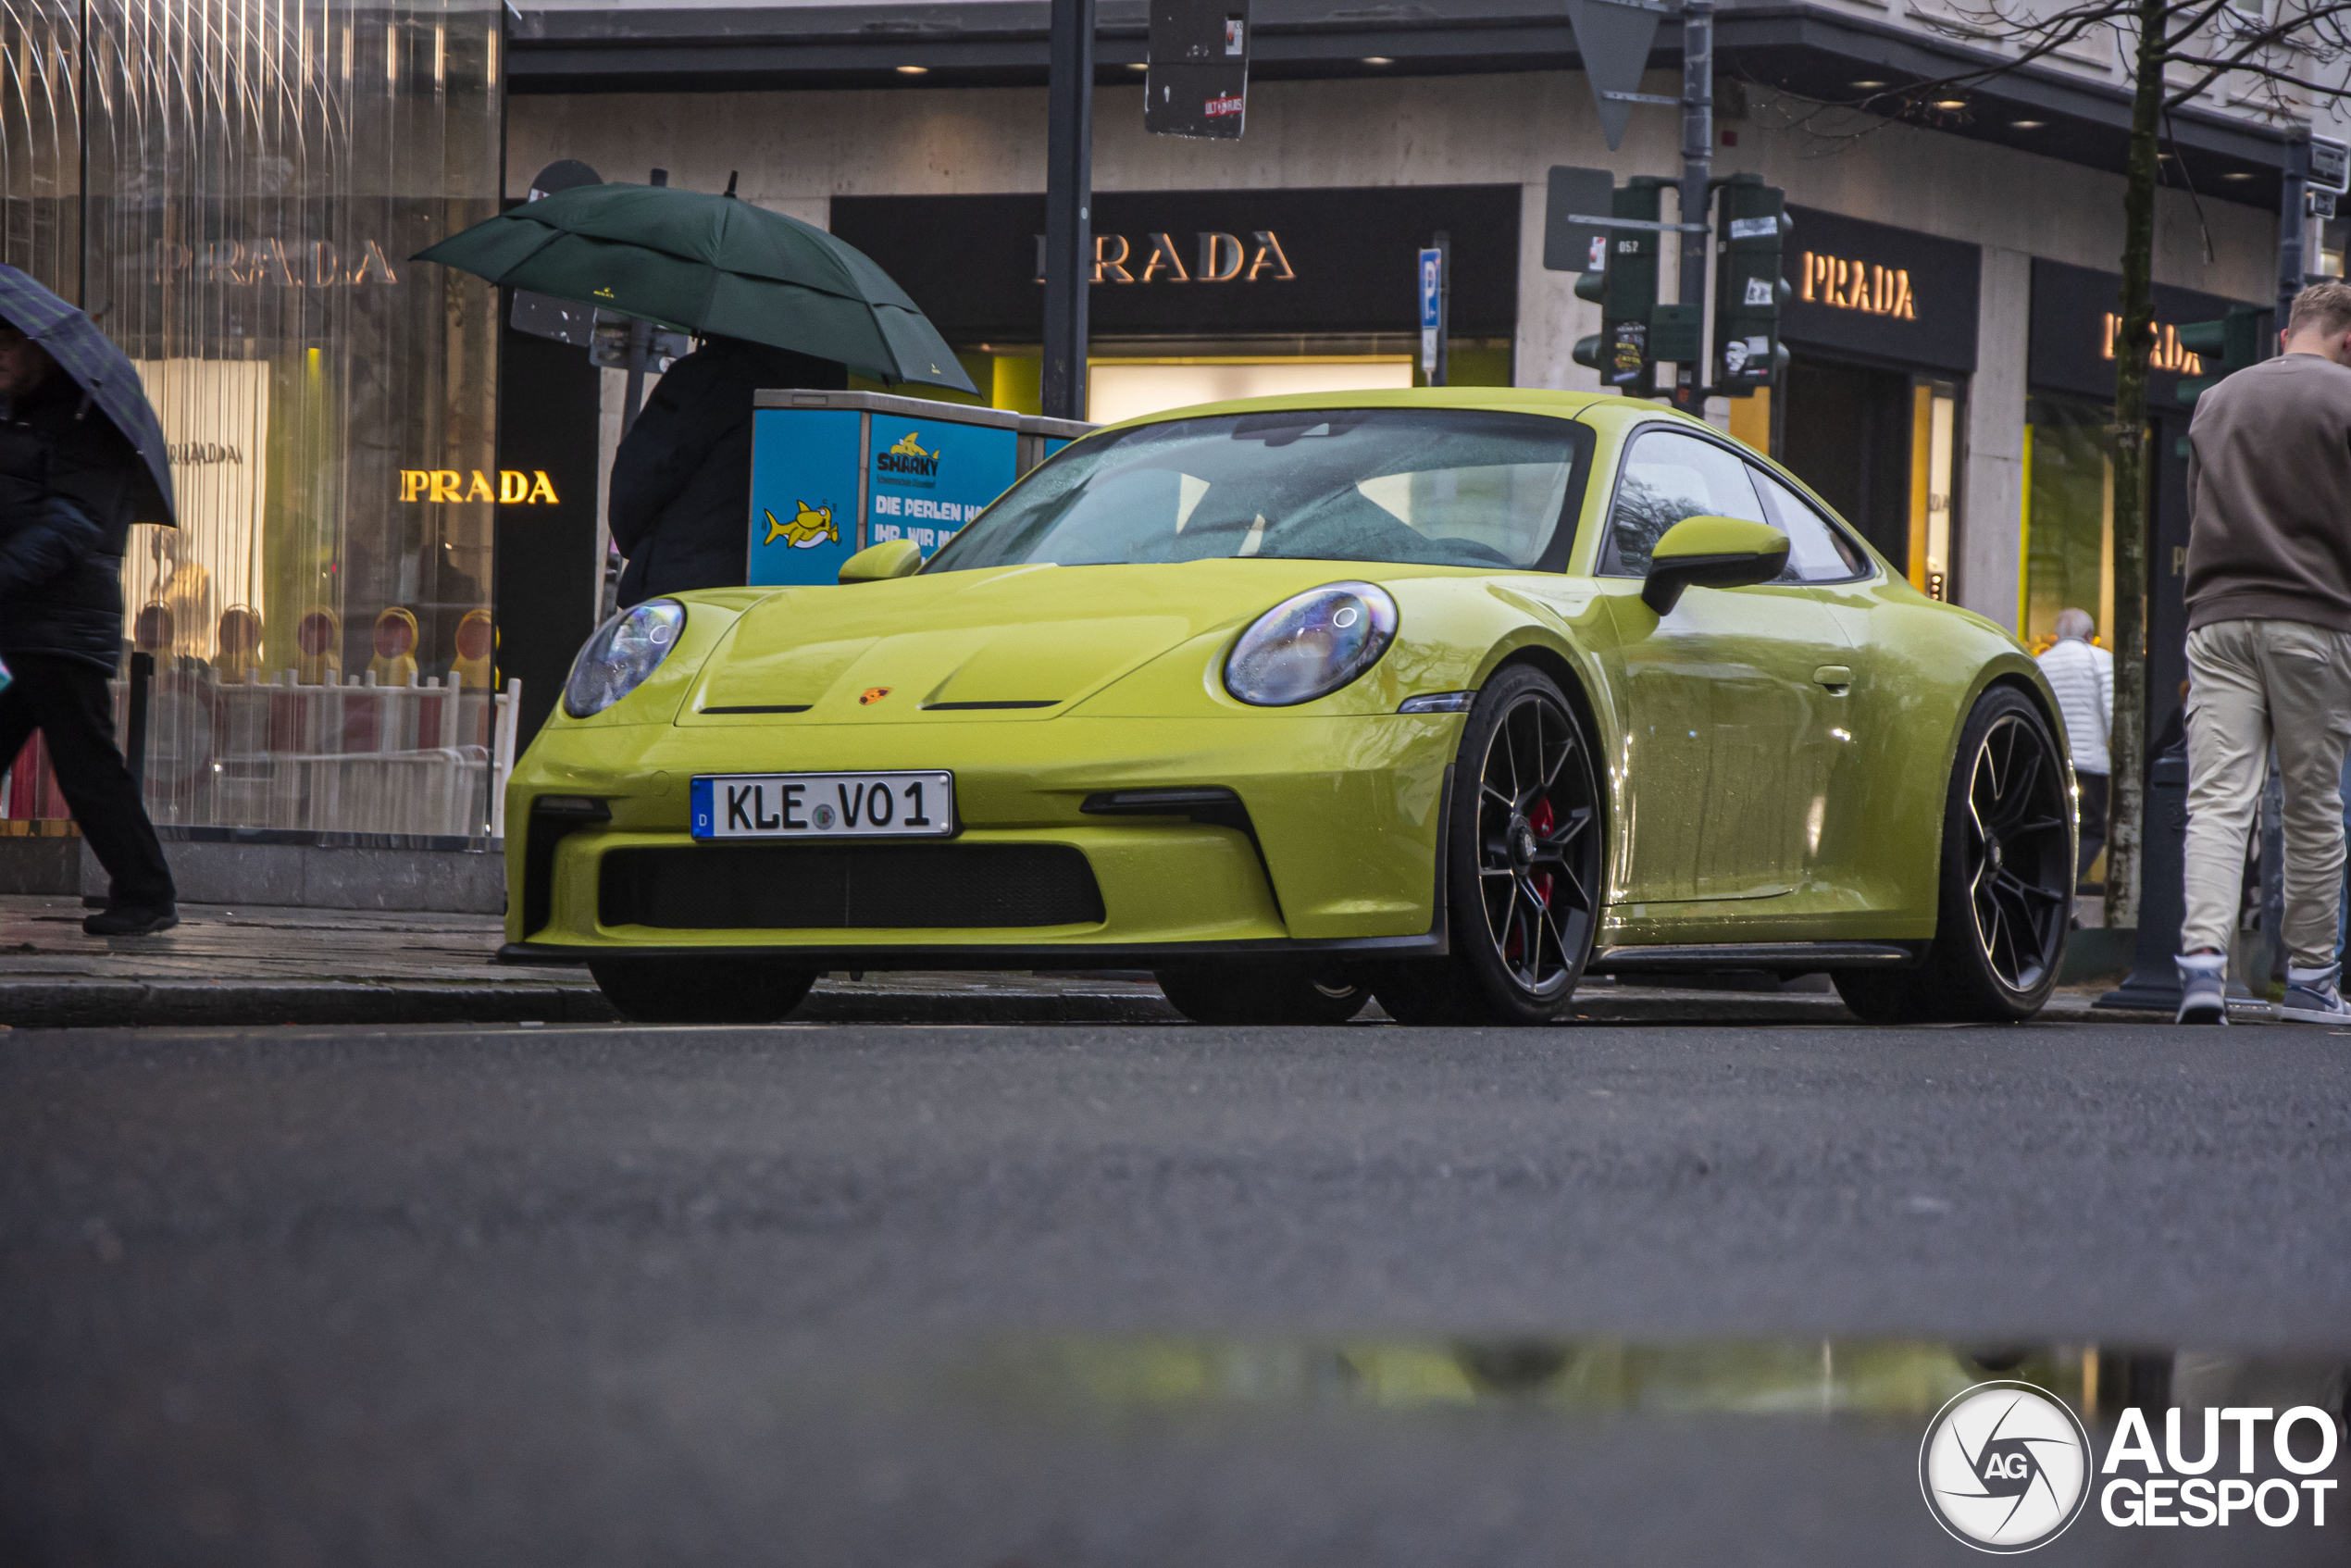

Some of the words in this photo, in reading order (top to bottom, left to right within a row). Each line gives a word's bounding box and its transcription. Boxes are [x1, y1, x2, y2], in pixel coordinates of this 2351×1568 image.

[1424, 260, 1436, 319] P
[1802, 250, 1917, 320] PRADA
[2102, 312, 2203, 376] PADA
[877, 453, 938, 477] SHARKY
[399, 469, 560, 504] PRADA
[876, 494, 902, 516] DIE
[904, 498, 962, 521] PERLEN
[907, 527, 935, 547] WIR
[699, 814, 707, 827] D
[728, 783, 808, 829] KLE
